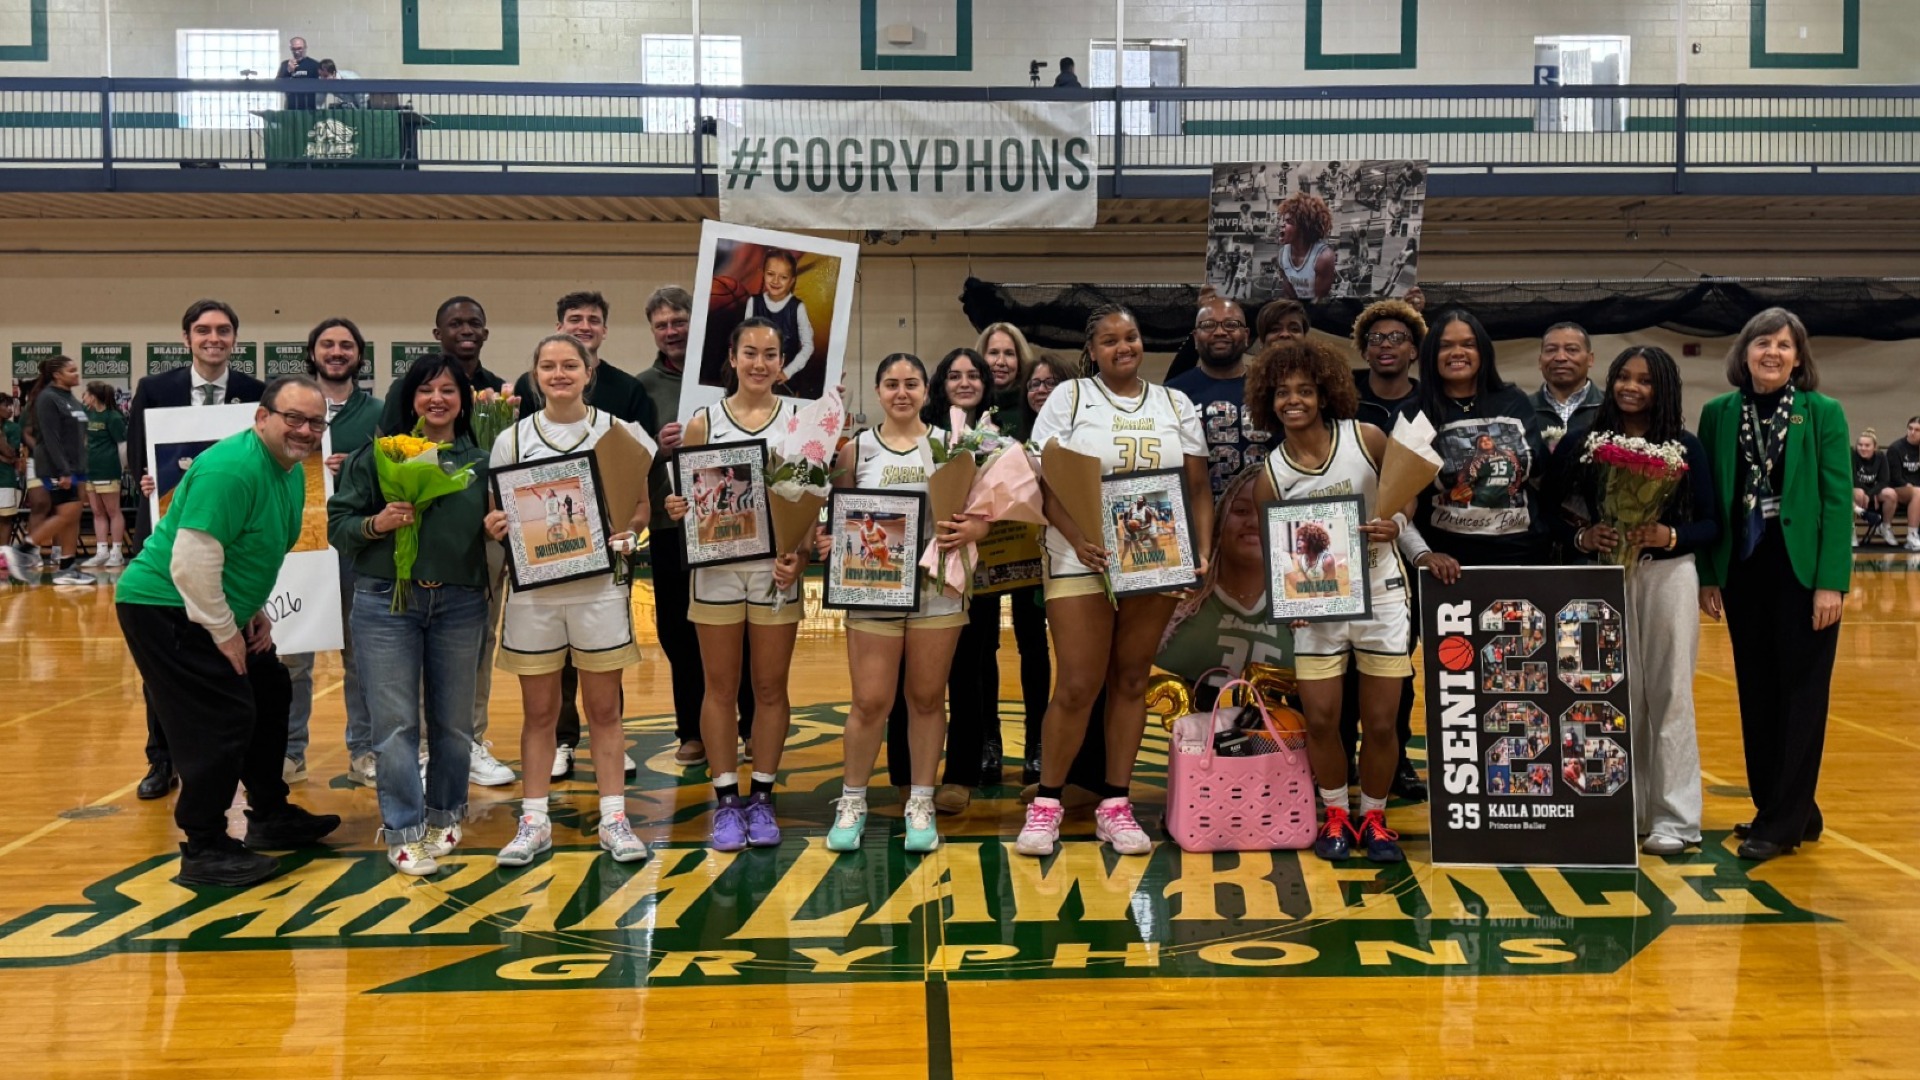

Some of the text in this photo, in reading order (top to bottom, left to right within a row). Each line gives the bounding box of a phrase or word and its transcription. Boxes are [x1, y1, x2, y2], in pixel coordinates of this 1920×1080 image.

[726, 136, 1091, 193] #GOGRYPHONS
[90, 346, 122, 355] MASON
[153, 346, 190, 355] BRADEN
[275, 346, 302, 354] CHRIS
[84, 360, 129, 375] 2026
[1112, 436, 1162, 474] 35
[878, 464, 927, 488] SARAH
[1489, 460, 1508, 476] 35
[1448, 803, 1575, 830] 35 KAILA DORCH
[1488, 821, 1547, 830] Princess Baller
[0, 836, 1783, 959] SARAH LAWRENCE
[496, 938, 1578, 980] GRYPHONS
